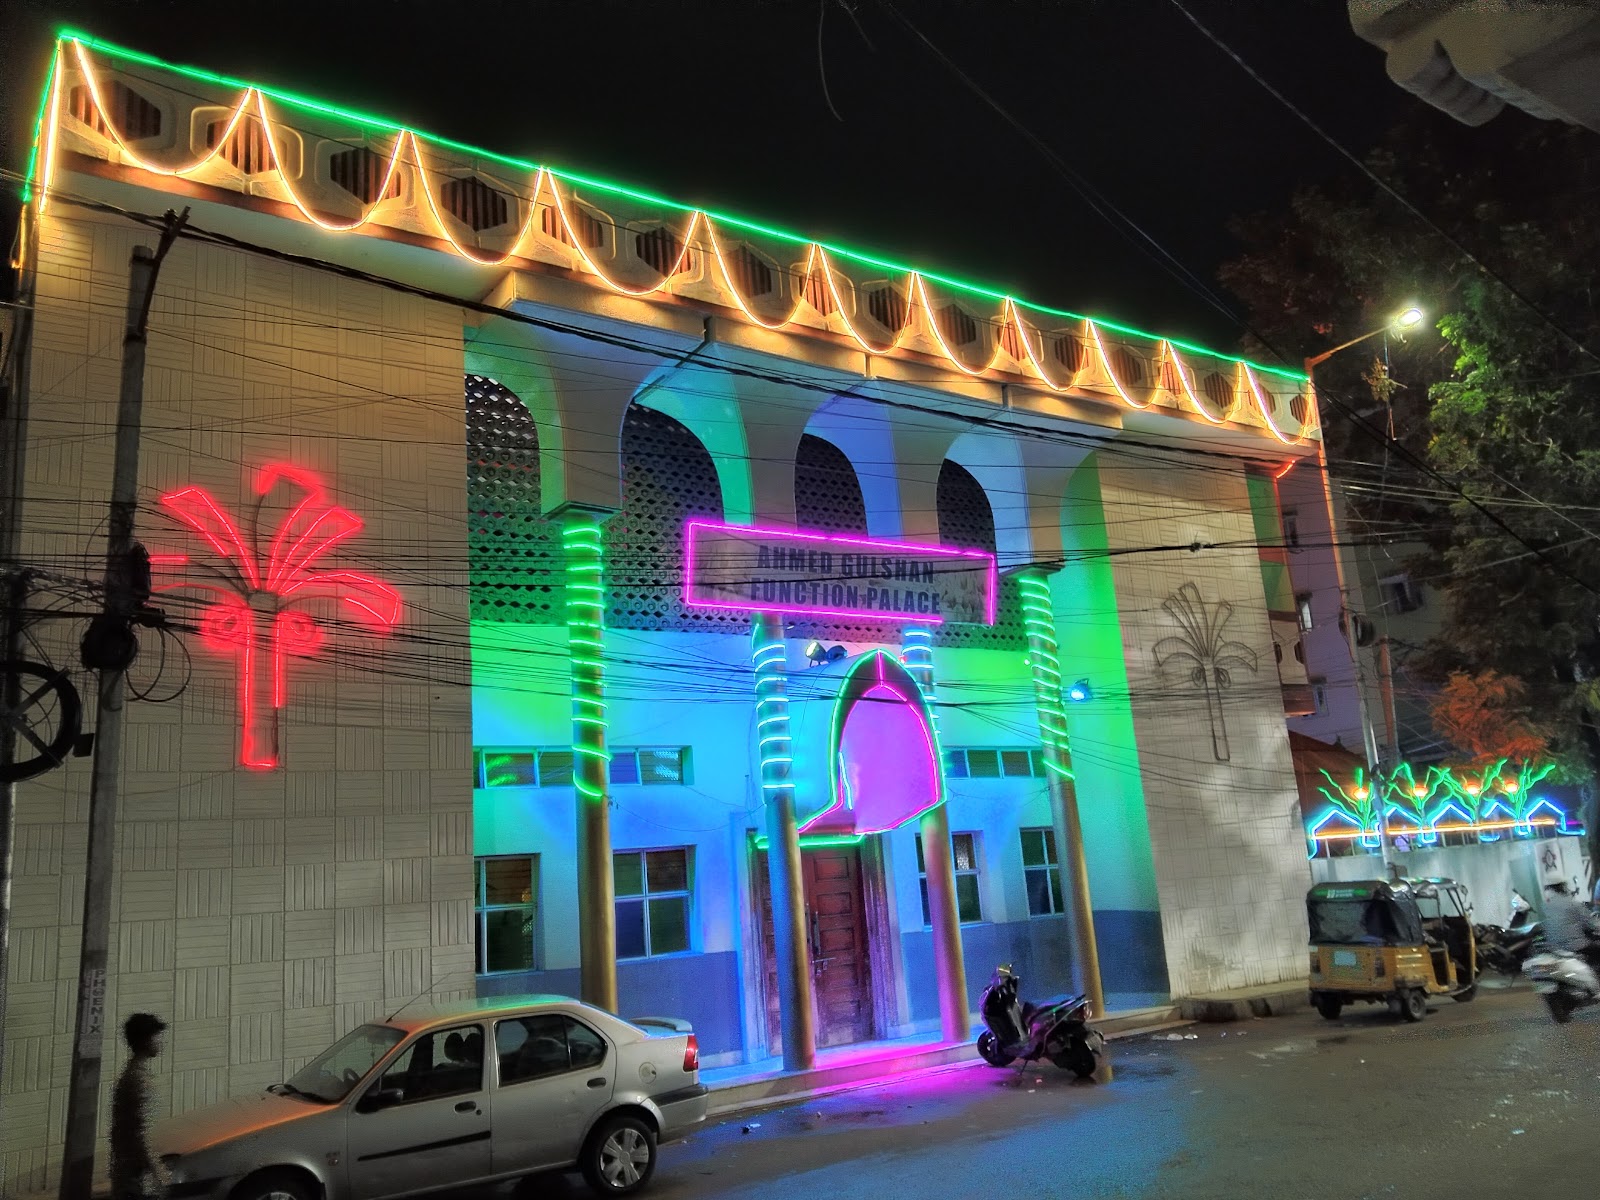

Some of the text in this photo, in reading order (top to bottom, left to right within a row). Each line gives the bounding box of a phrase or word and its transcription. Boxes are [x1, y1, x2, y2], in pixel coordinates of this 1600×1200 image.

[758, 545, 935, 584] AHMED GULSHAN
[751, 577, 940, 614] FUNCTION PALACE
